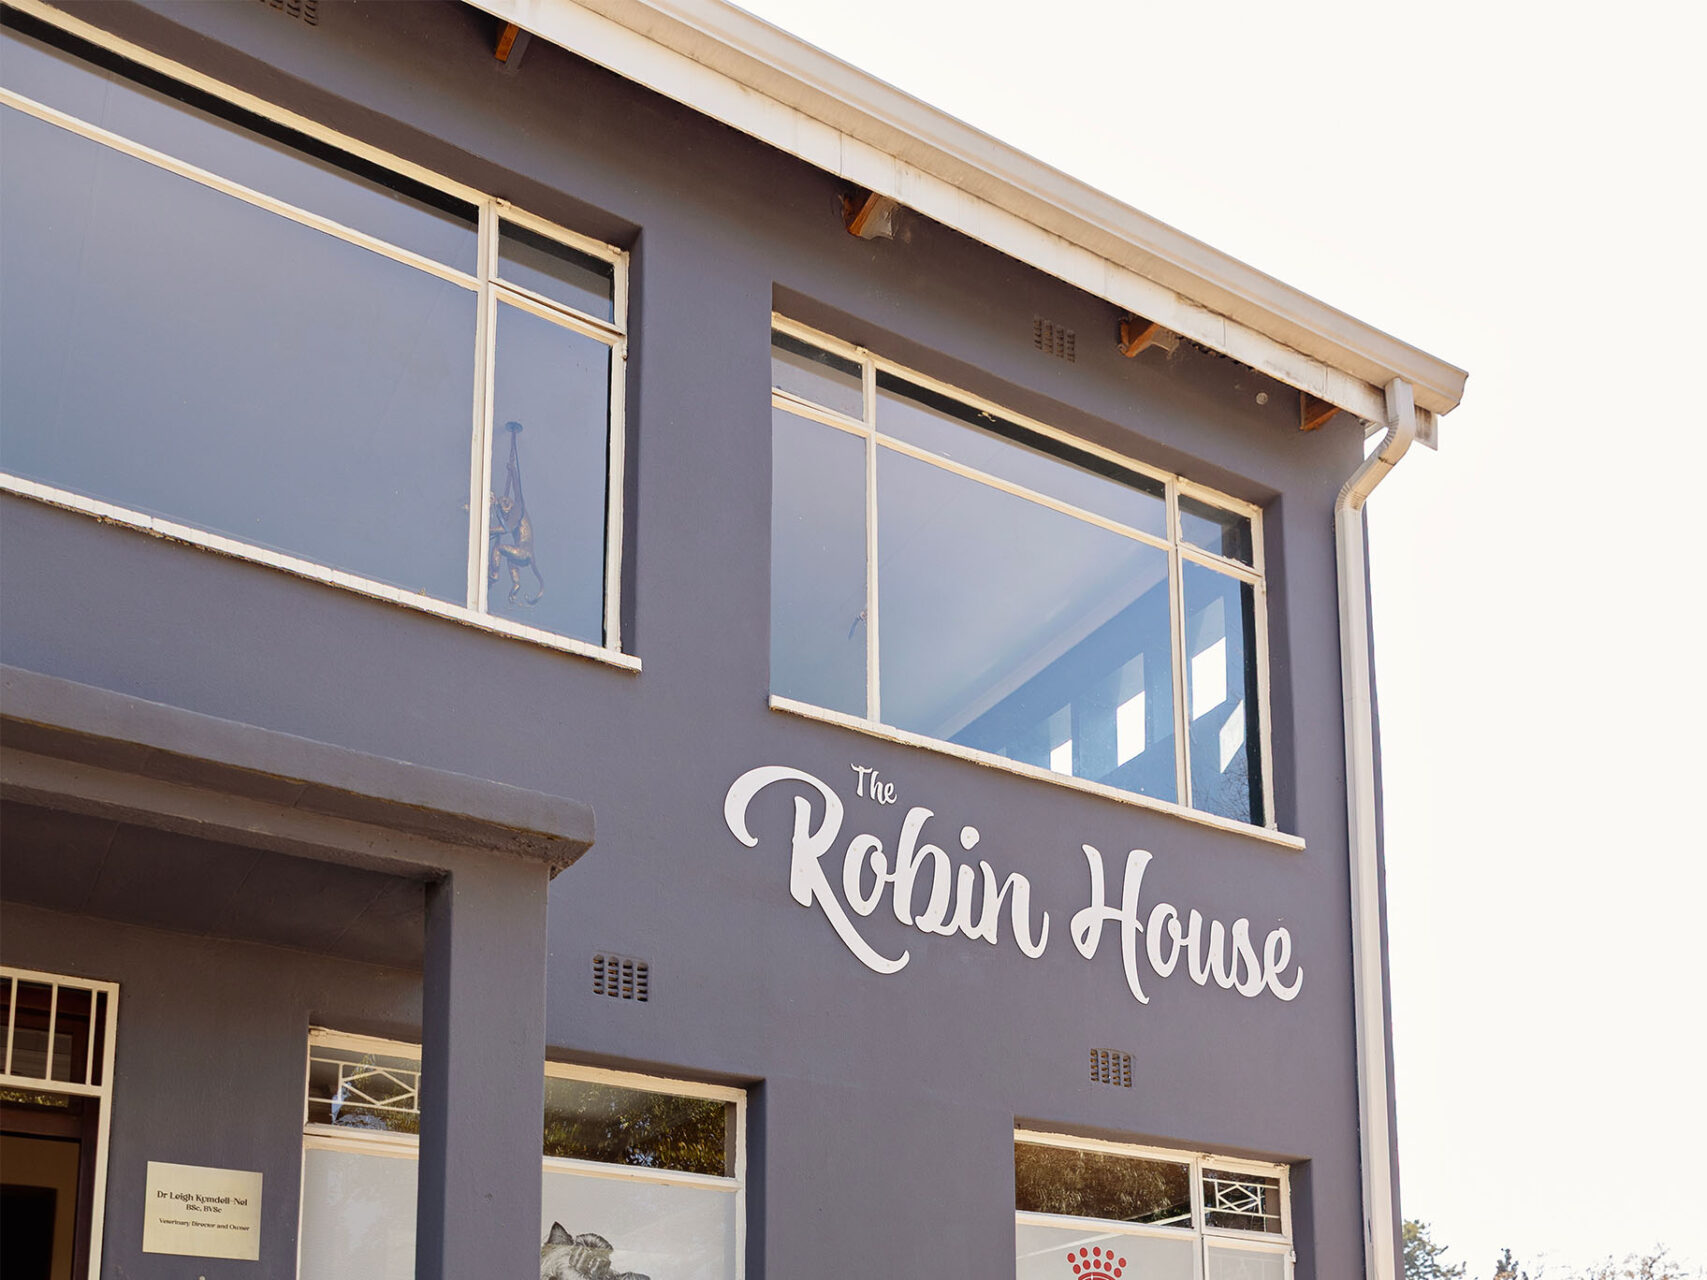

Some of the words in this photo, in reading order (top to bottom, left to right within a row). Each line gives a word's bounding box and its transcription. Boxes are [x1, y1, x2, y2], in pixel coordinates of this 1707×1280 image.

[850, 763, 897, 805] The
[724, 765, 1049, 975] Robin
[1070, 843, 1304, 1005] House
[170, 1192, 194, 1202] Leigh
